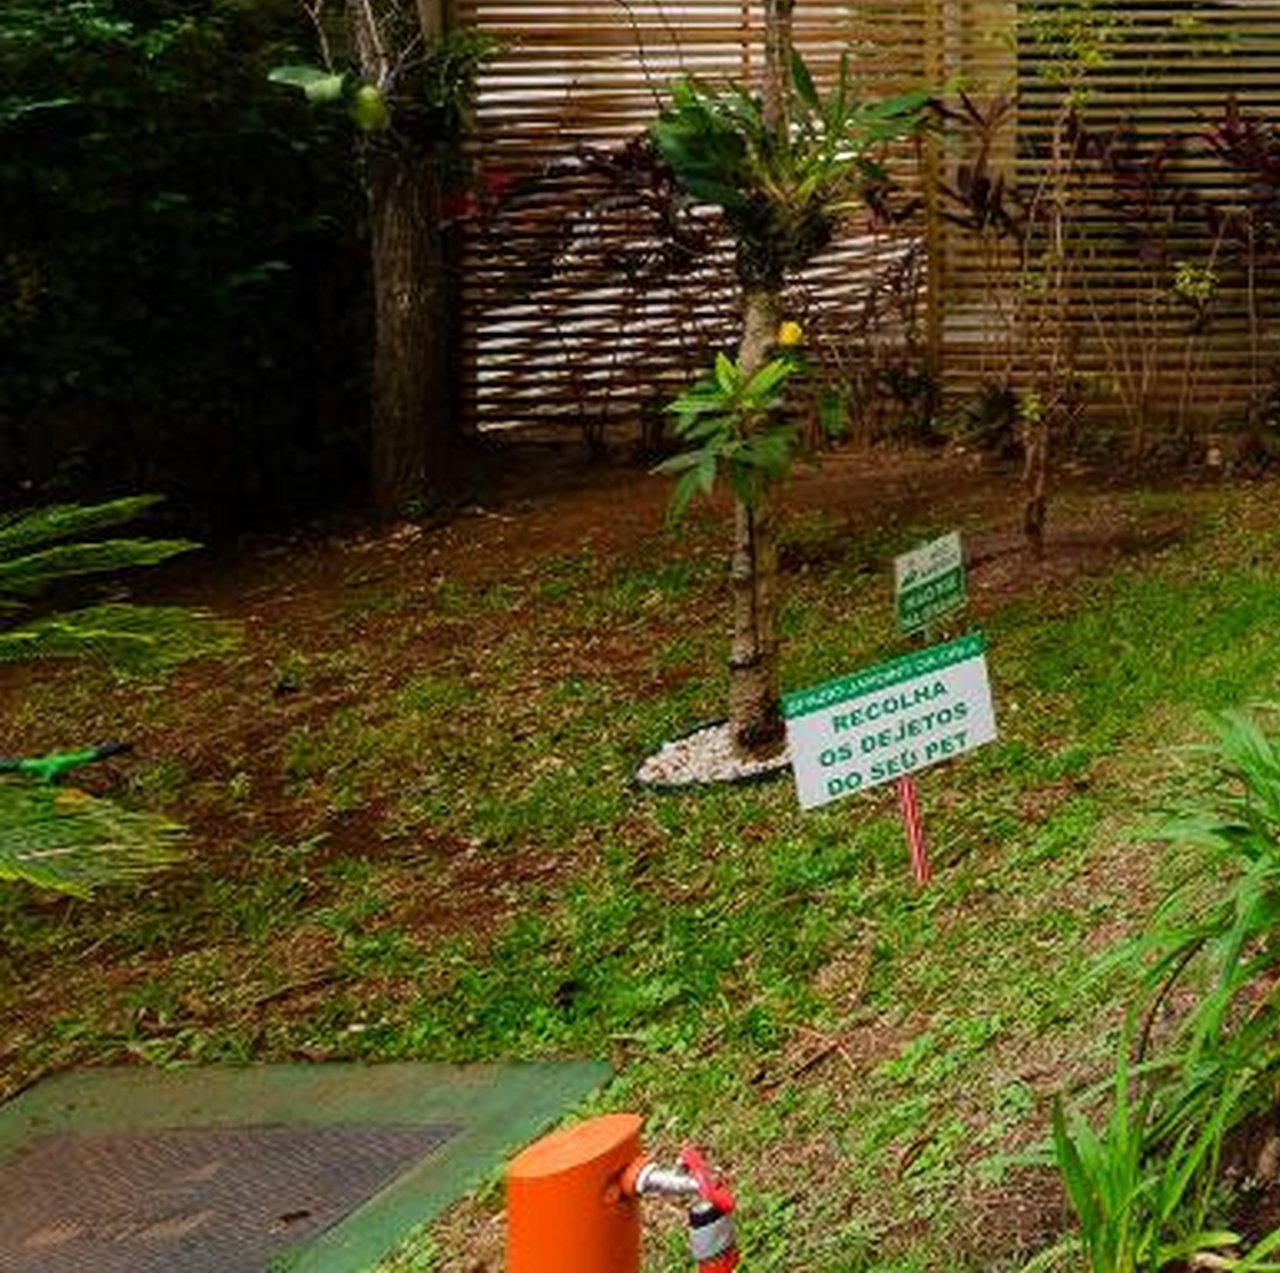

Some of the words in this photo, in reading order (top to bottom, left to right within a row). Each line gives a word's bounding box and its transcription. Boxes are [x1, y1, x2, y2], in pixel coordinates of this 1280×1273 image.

[819, 740, 852, 767] OS
[860, 702, 969, 753] DEJETOS
[832, 681, 948, 733] RECOLHA
[827, 772, 862, 796] DO
[870, 748, 918, 780] SEU
[924, 731, 967, 760] PET
